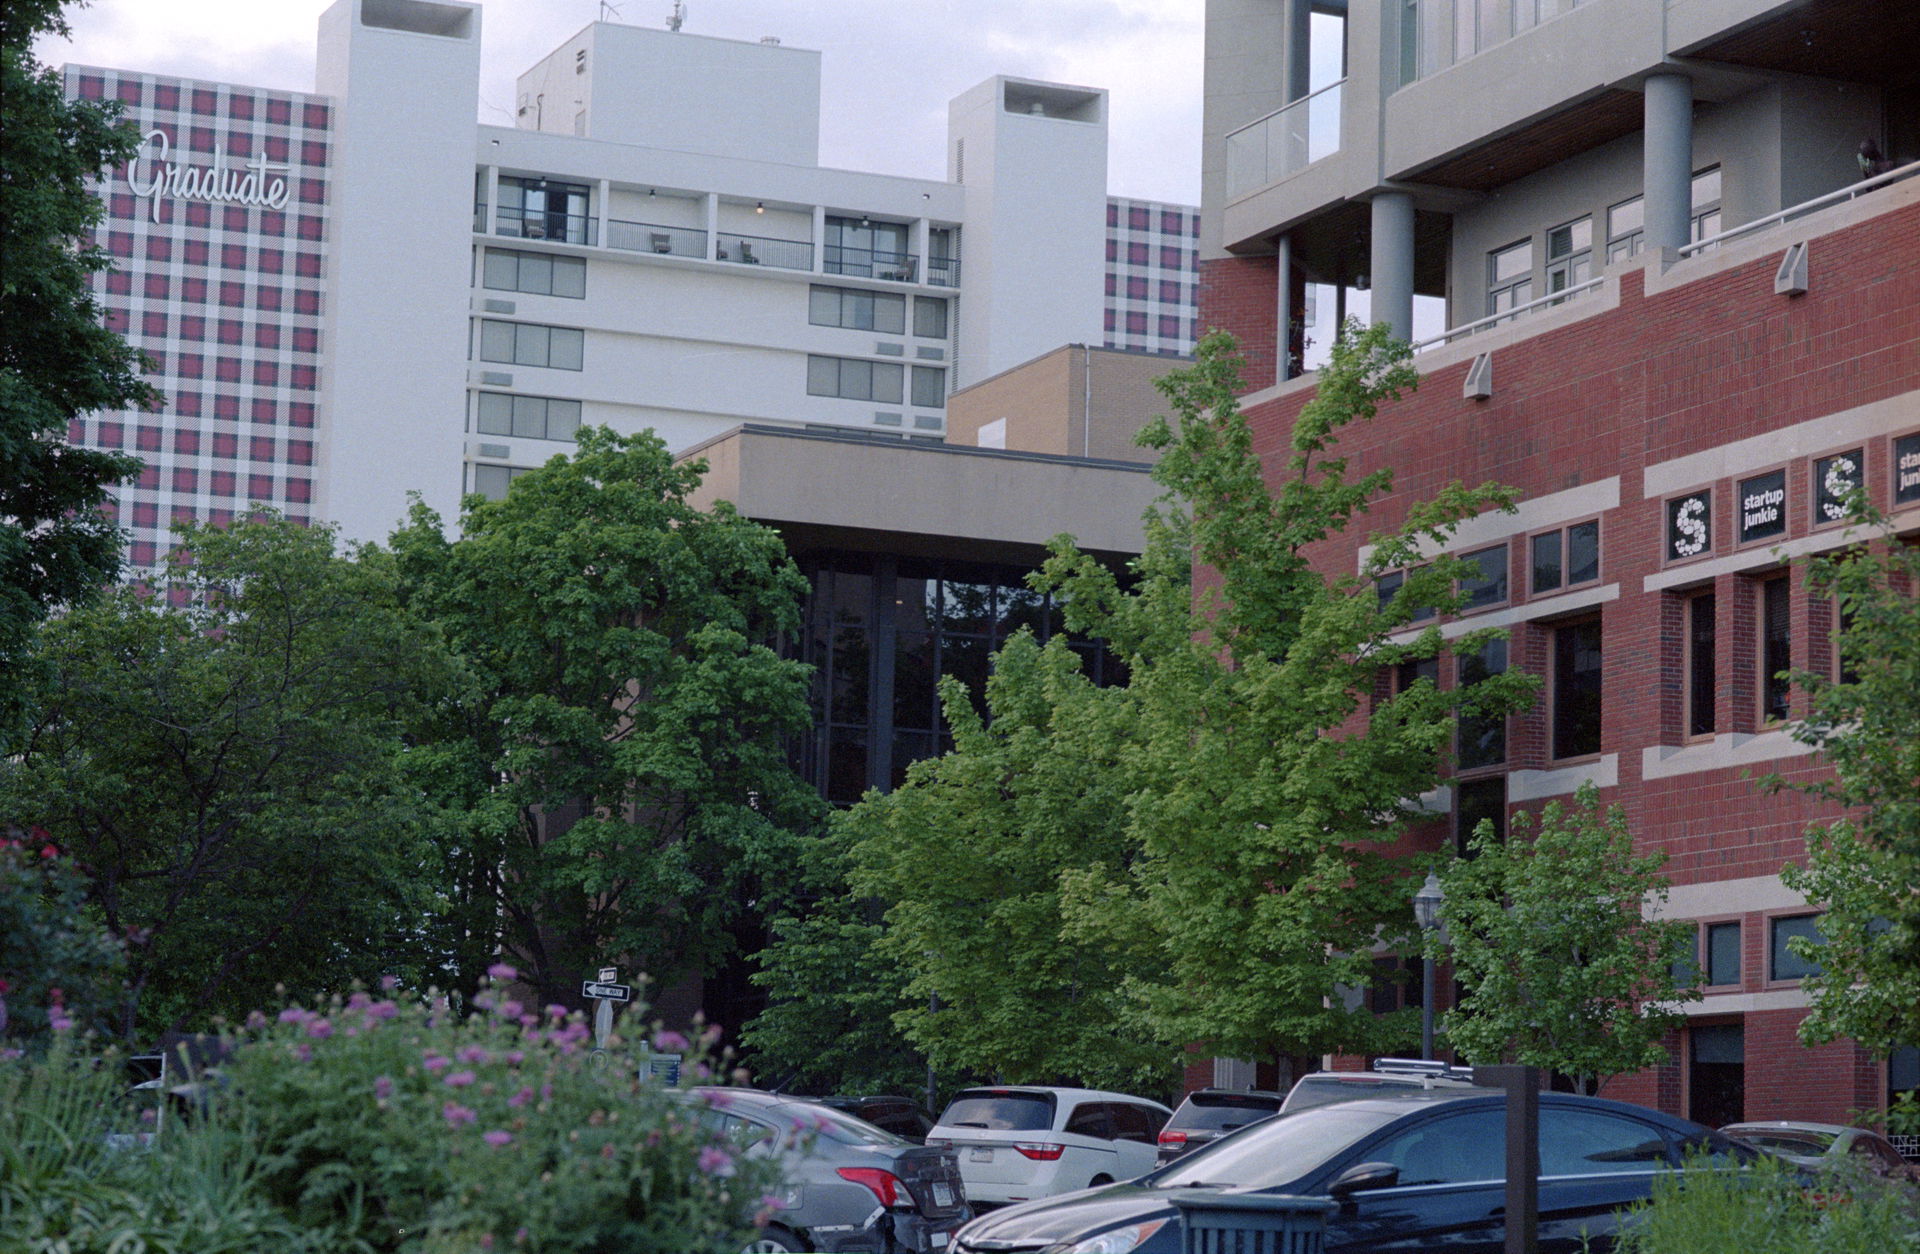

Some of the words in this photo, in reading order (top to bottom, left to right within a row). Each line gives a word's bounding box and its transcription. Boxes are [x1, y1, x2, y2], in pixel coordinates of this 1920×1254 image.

[127, 129, 291, 225] Graduate
[1744, 488, 1784, 510] startup
[1744, 506, 1778, 531] junkie
[609, 988, 622, 996] WAY
